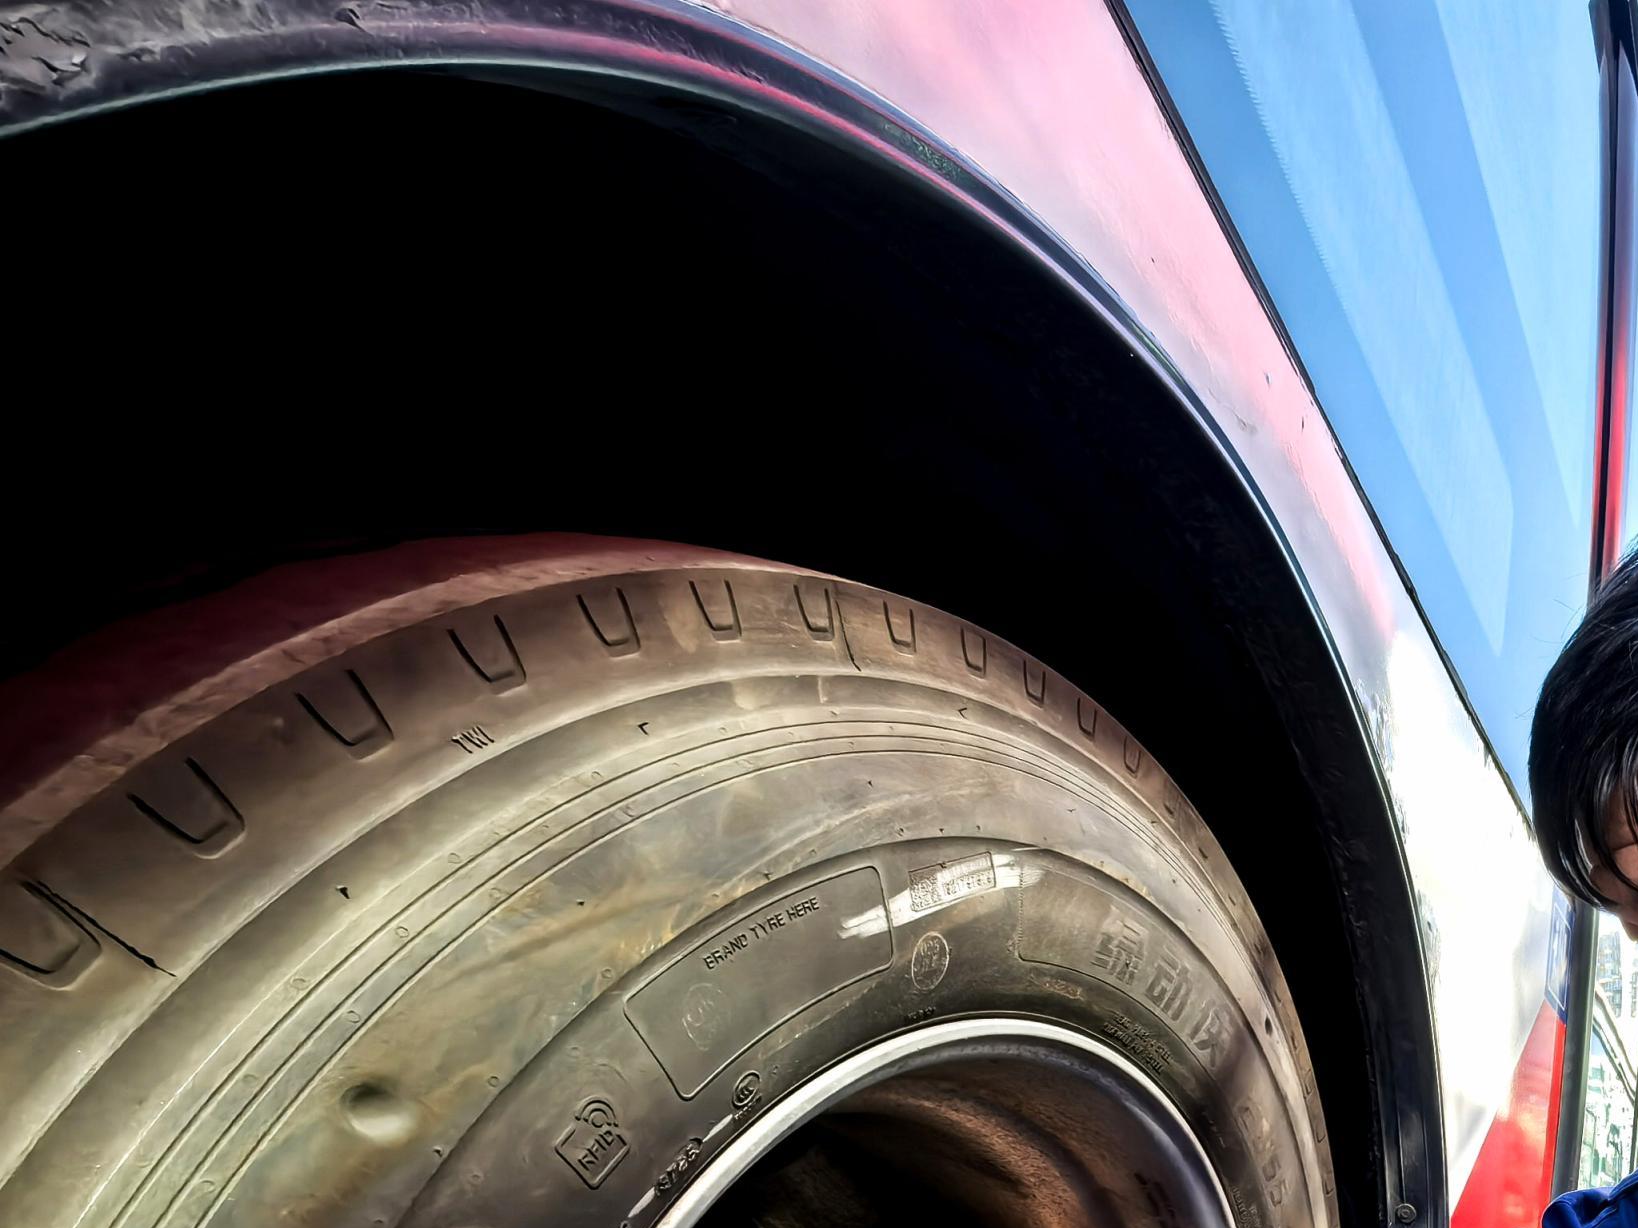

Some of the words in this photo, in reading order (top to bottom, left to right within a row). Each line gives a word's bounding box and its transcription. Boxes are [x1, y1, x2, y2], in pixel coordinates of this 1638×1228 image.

[451, 724, 496, 756] TWI
[703, 933, 748, 971] BRAND
[749, 912, 786, 940] TYRE
[786, 896, 820, 922] HERE
[578, 1128, 618, 1173] RFID
